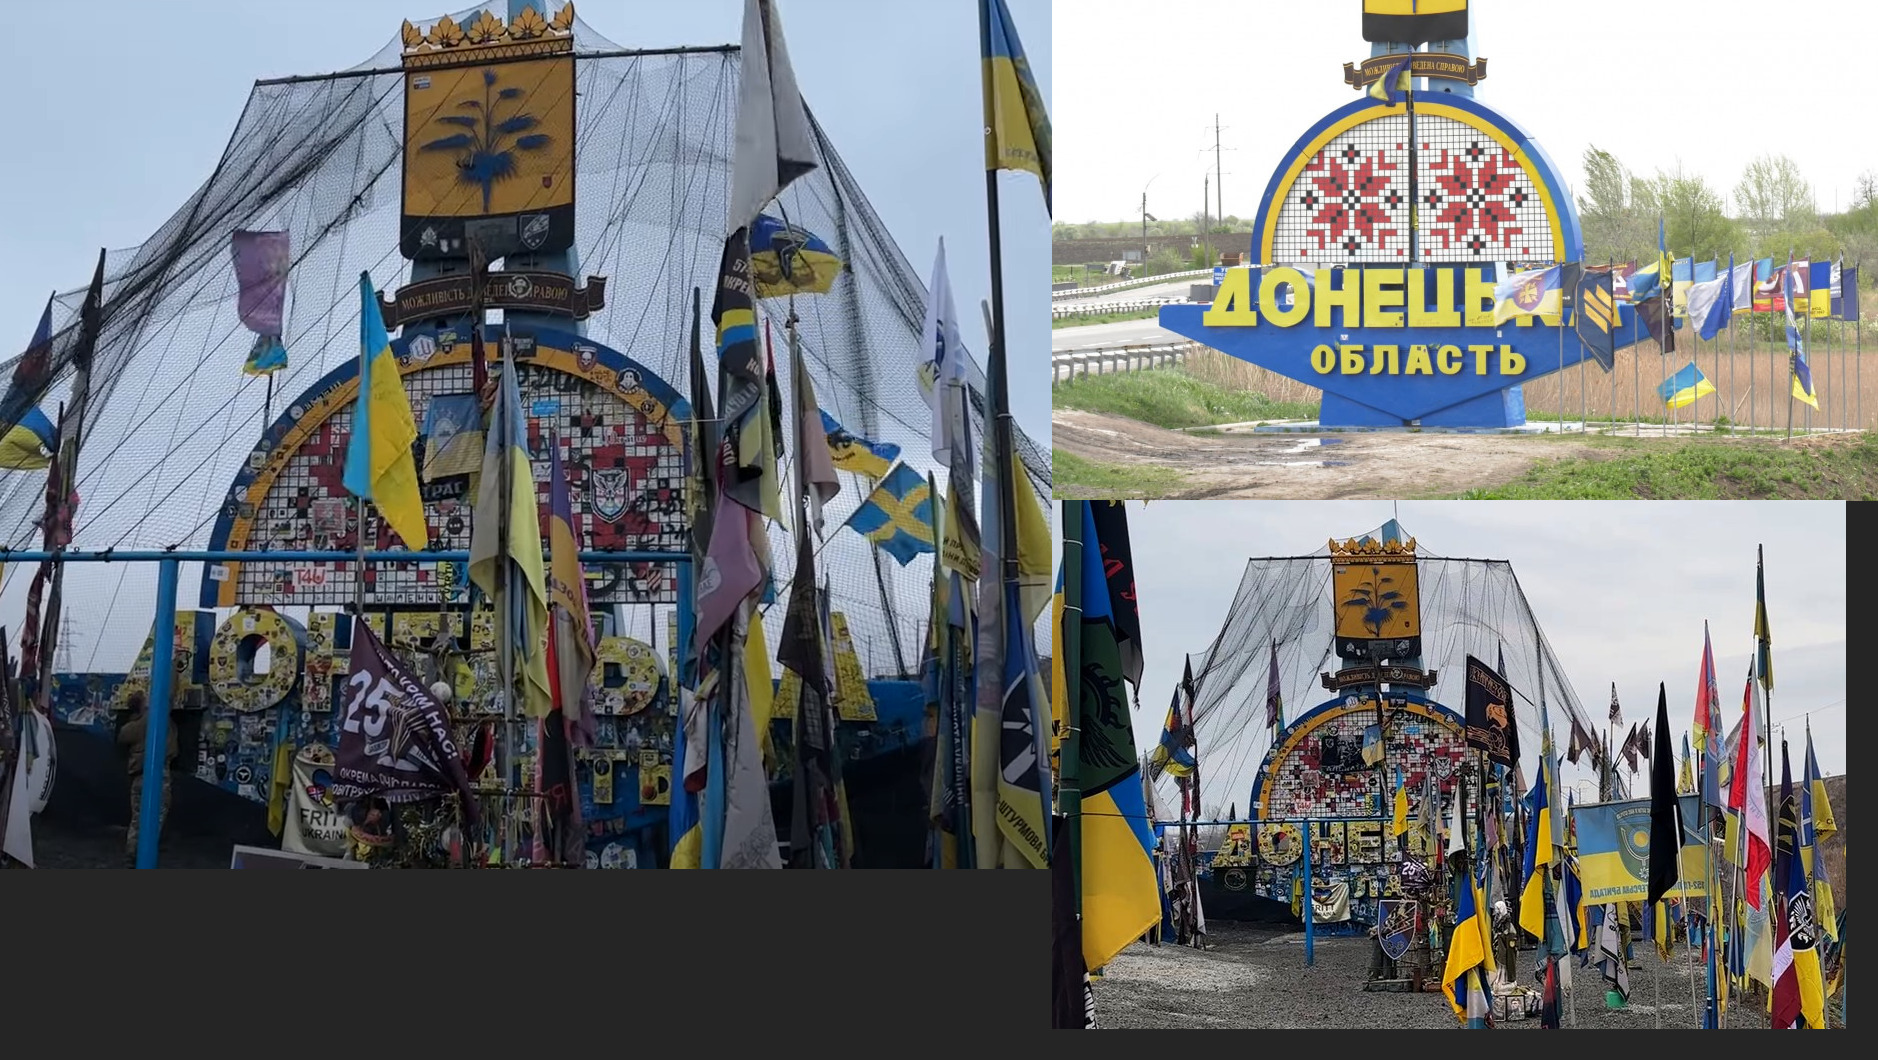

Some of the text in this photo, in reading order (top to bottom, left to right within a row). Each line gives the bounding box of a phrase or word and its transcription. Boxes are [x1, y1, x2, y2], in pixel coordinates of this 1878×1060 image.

[1411, 60, 1435, 71] ВЕДЕНА
[401, 287, 466, 311] МОЖЛИВІСТЬ
[530, 285, 569, 301] РАВОЮ
[1203, 267, 1622, 328] ДОНЕЦЬ
[1311, 344, 1527, 375] ОБЛАСТЬ
[294, 568, 326, 585] T4U
[343, 669, 404, 738] 25
[425, 711, 459, 759] НАС!
[340, 767, 380, 784] ОКРЕМА
[300, 808, 337, 827] FRIT
[998, 799, 1044, 853] ШТУРМОВА
[1401, 861, 1417, 876] 25
